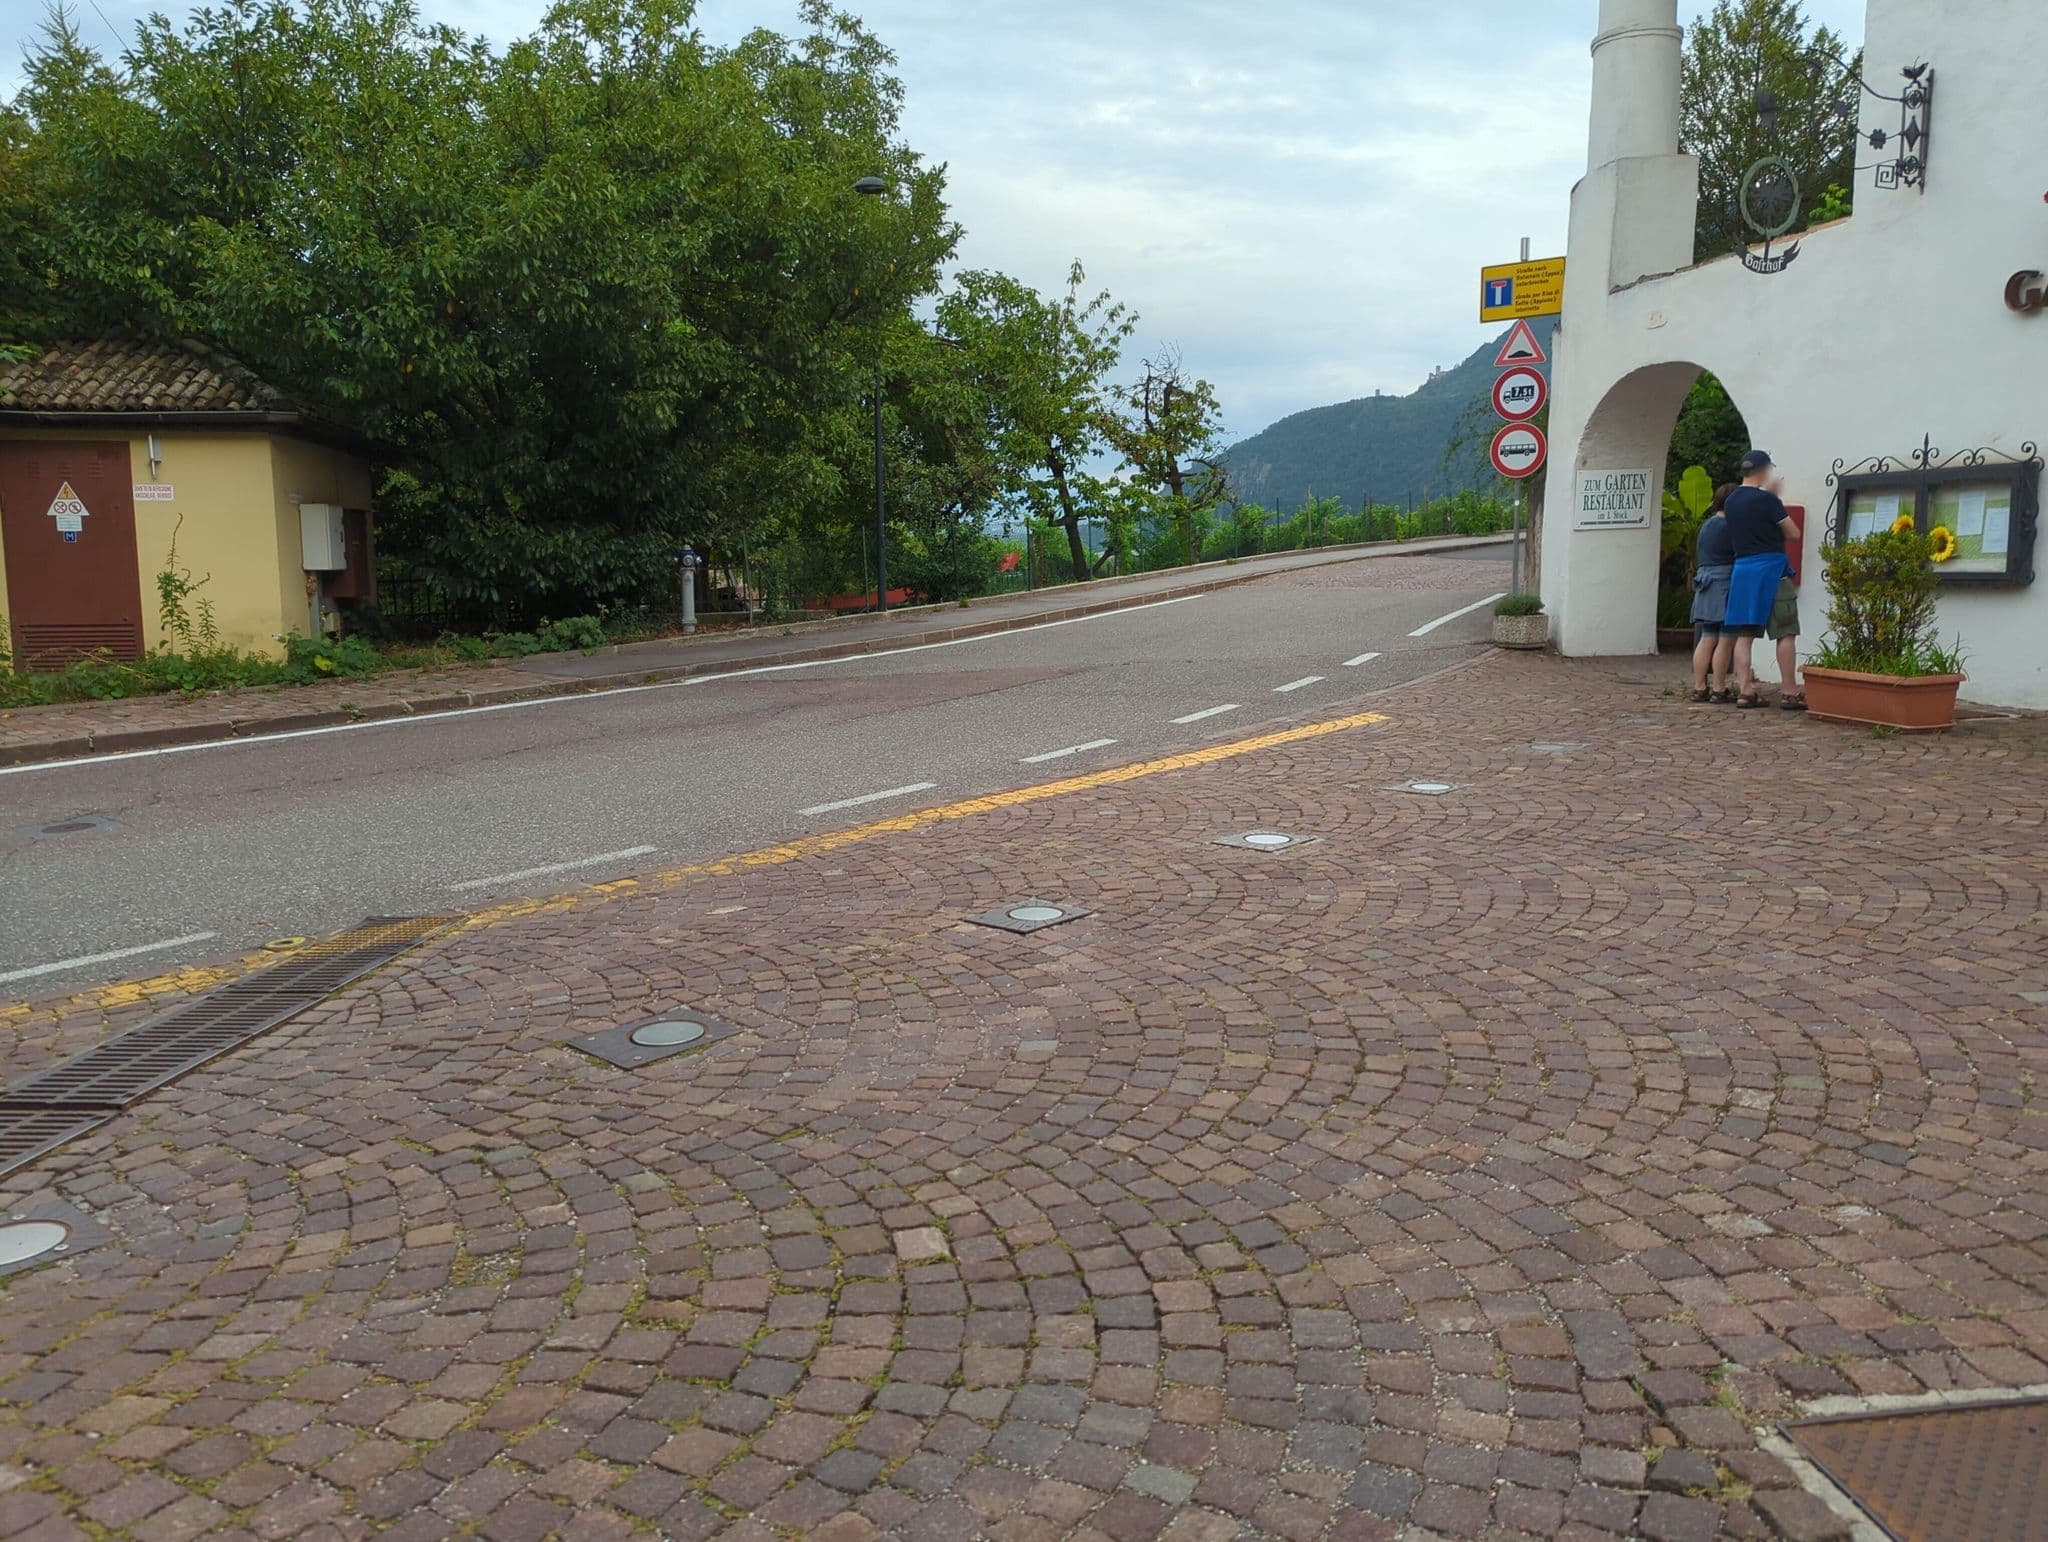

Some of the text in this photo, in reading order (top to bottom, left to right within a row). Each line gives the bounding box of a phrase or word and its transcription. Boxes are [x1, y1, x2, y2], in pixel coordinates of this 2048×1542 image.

[1584, 473, 1647, 491] ZUM GARTEN
[1583, 493, 1646, 511] RESTAURANT
